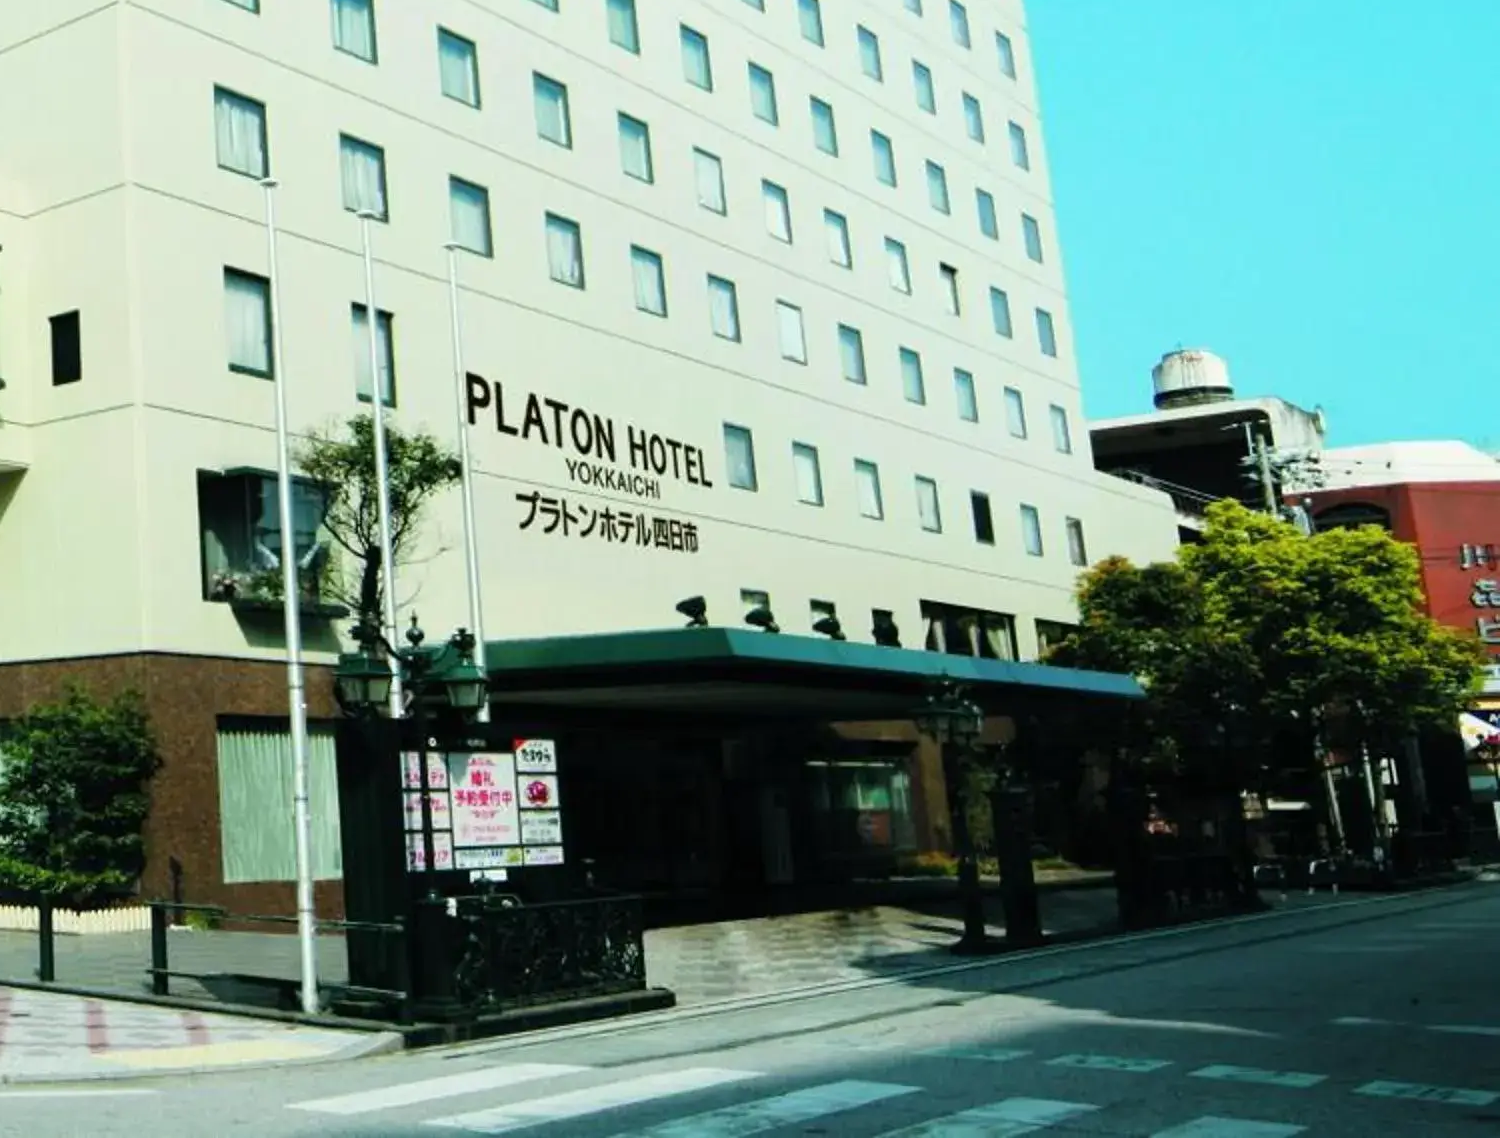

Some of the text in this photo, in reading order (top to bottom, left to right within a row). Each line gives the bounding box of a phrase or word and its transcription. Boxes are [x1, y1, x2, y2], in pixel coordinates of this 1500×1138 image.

[465, 371, 713, 488] PLATON HOTEL
[565, 458, 660, 500] YOKKAICHI
[515, 491, 699, 553] プラトンホテル四日市
